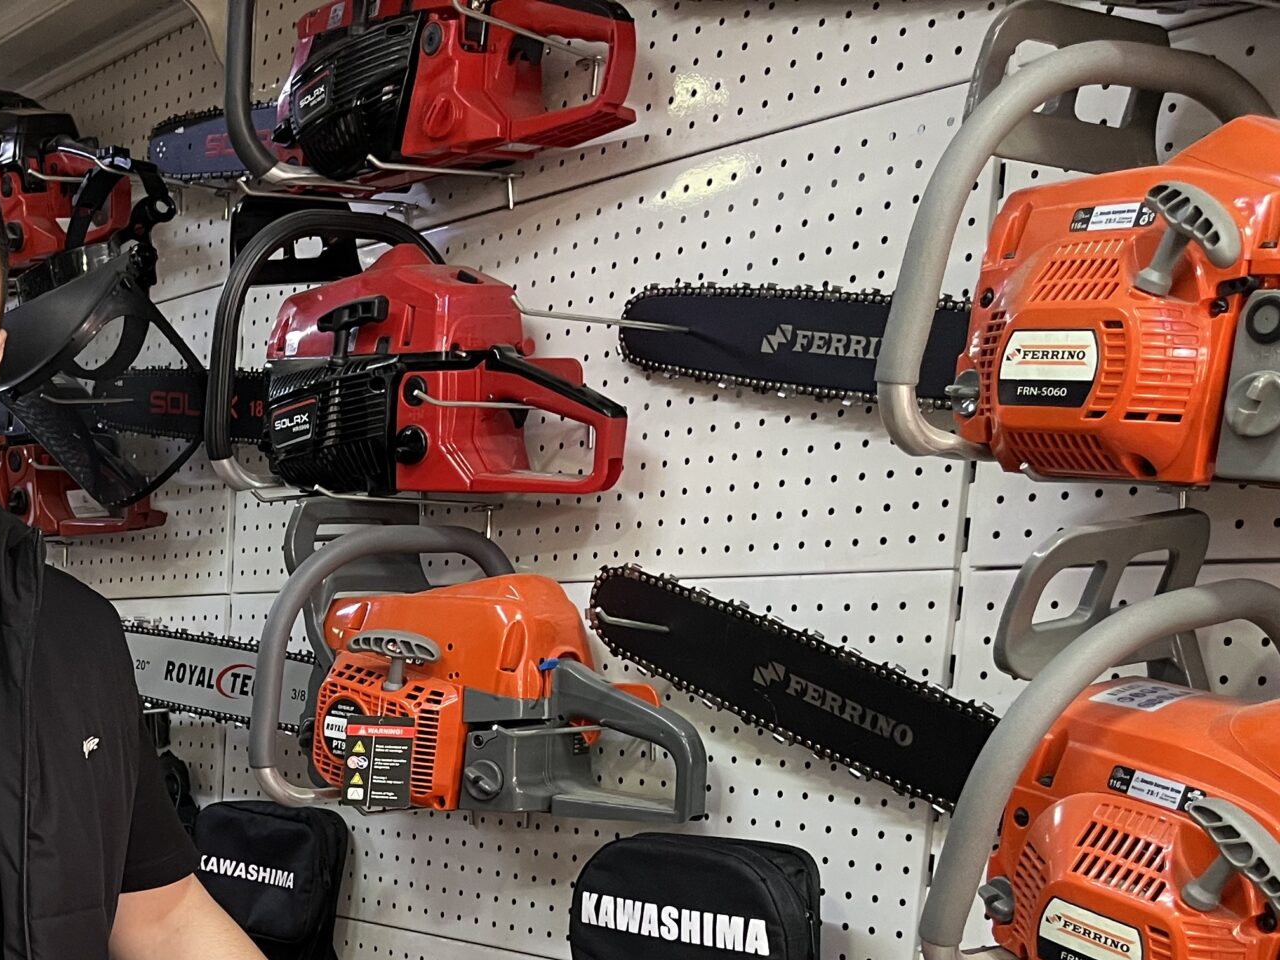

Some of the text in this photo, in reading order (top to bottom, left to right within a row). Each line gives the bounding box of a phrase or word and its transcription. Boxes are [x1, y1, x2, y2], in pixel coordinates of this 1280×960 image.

[300, 85, 325, 108] SOLAX
[792, 330, 880, 359] FERRI
[1021, 350, 1086, 360] FERRINO
[1016, 386, 1067, 397] FRN-5060
[149, 390, 239, 420] SOLX
[274, 412, 309, 430] SOLAX
[164, 660, 215, 690] ROYAL
[230, 672, 256, 697] TE
[291, 688, 306, 702] 3/8
[785, 673, 914, 747] FERRINO
[325, 722, 344, 733] ROYAL
[367, 727, 403, 736] WARNING!
[332, 739, 346, 750] PT9
[200, 854, 295, 889] KAWASHIMA
[581, 891, 770, 956] KAWASHIMA
[1062, 919, 1131, 954] FERRINO
